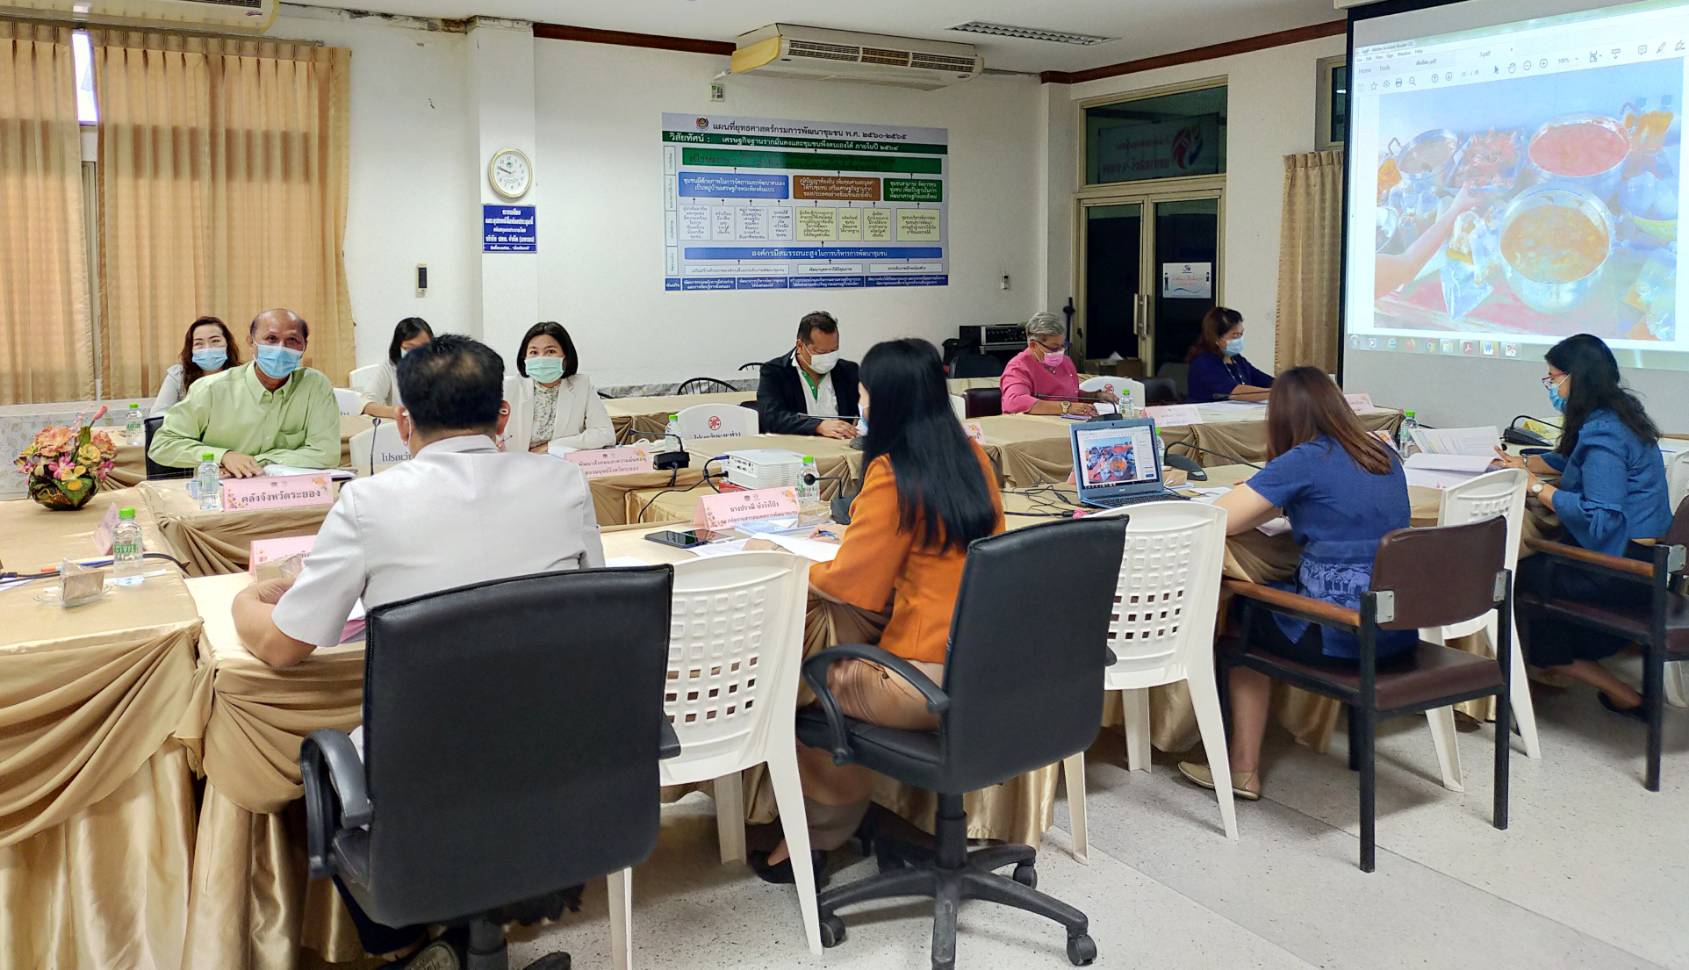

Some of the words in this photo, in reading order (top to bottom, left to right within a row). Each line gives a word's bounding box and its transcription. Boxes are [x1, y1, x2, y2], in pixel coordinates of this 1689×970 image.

[669, 132, 704, 142] วิสัยทัศน์
[241, 489, 321, 504] คลังจังหวัดระยอง
